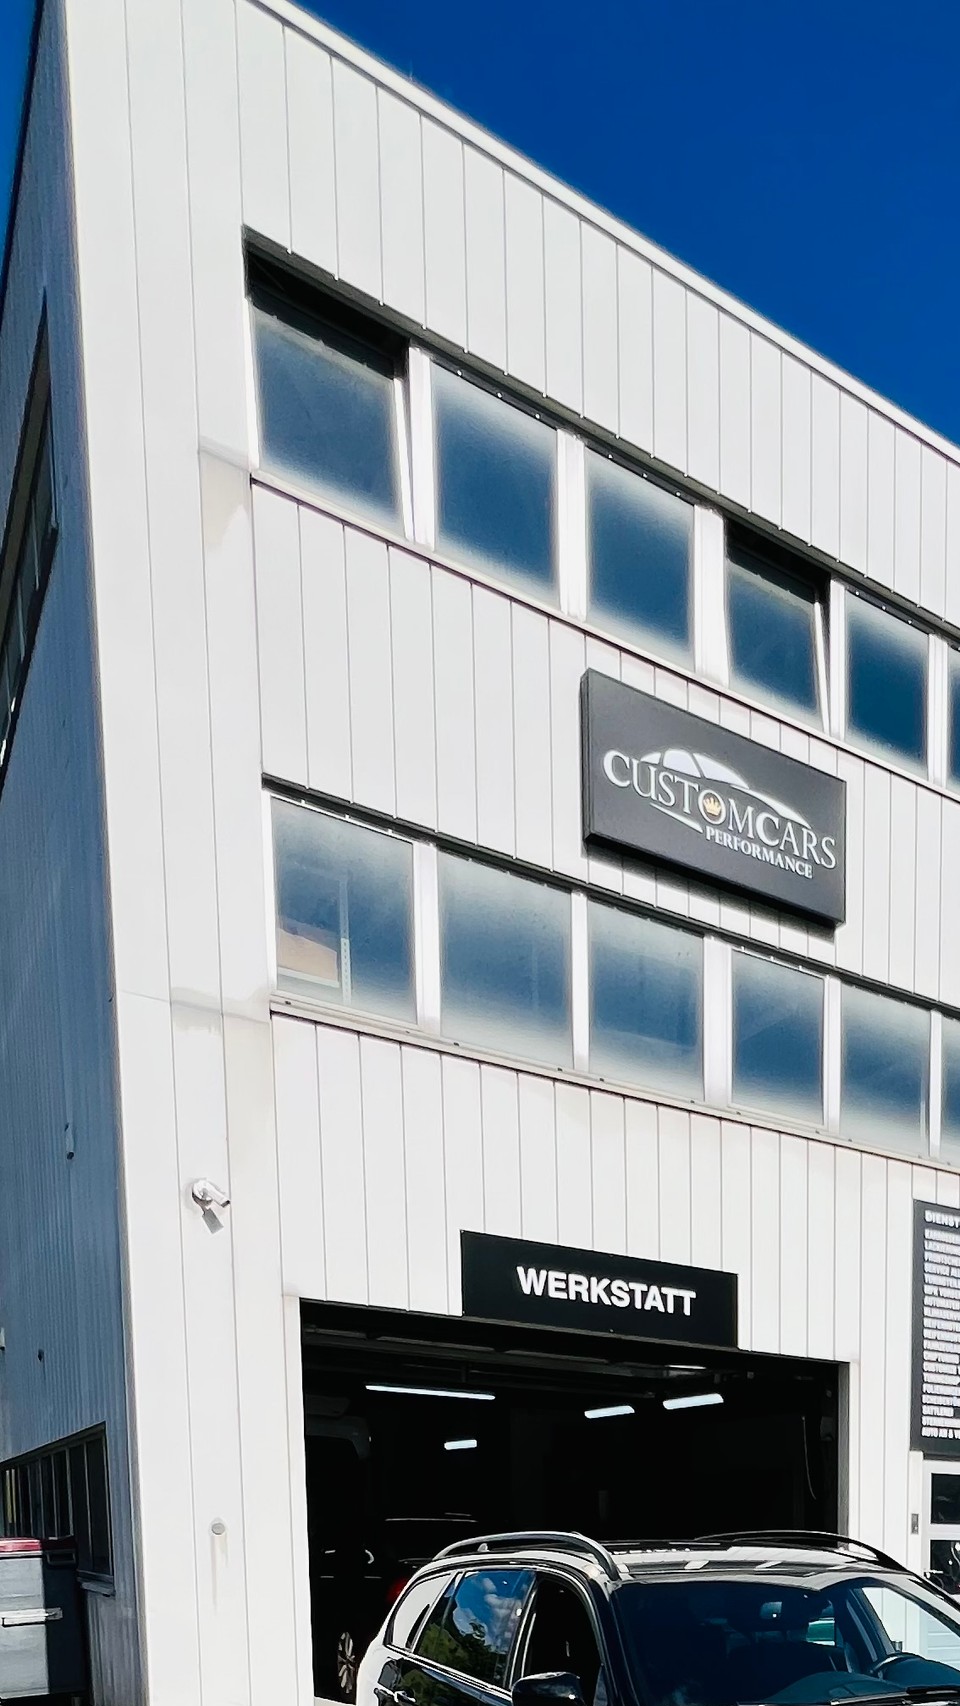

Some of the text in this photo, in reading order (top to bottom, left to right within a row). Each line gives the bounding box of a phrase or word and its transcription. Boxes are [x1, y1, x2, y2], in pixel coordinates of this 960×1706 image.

[603, 750, 836, 869] CUSTOMCARS
[705, 824, 813, 879] PERFORMANCE
[516, 1266, 697, 1316] WERKSTATT
